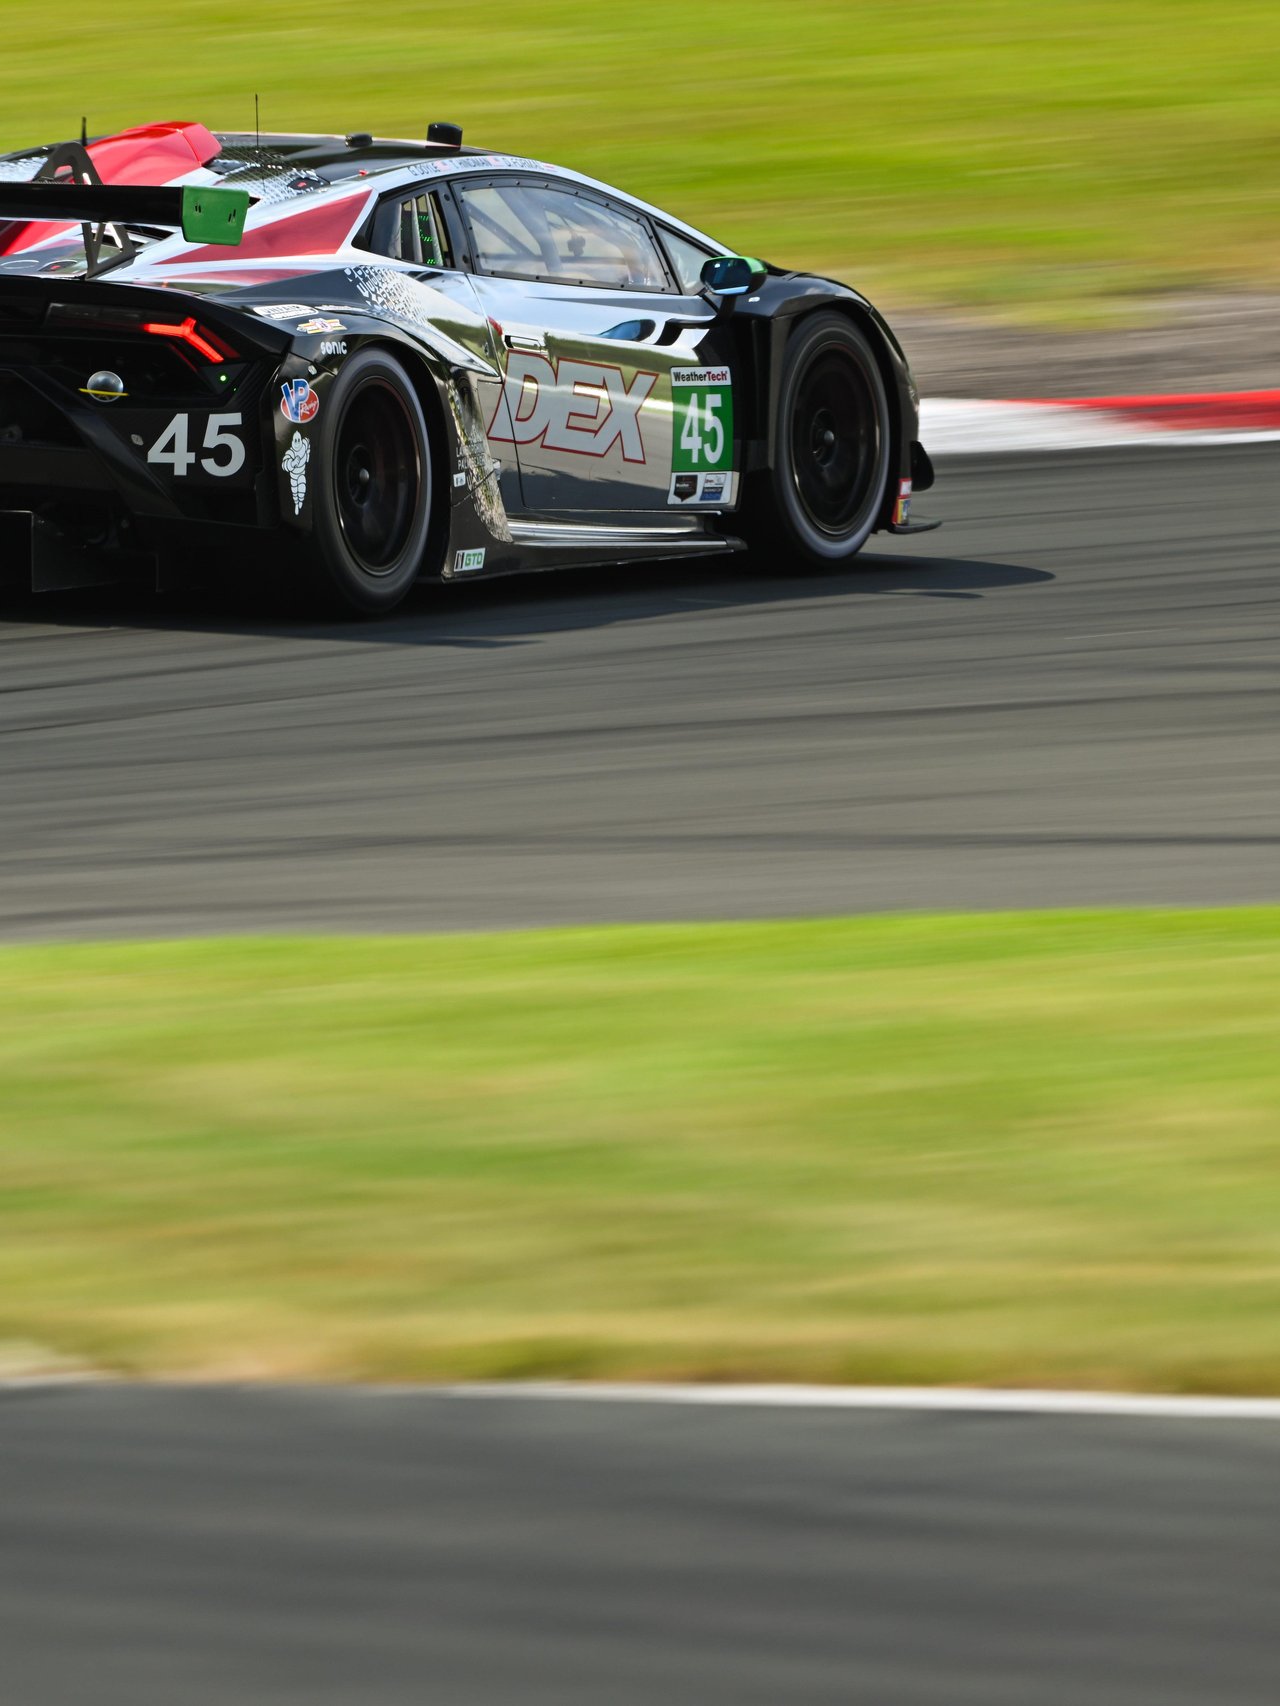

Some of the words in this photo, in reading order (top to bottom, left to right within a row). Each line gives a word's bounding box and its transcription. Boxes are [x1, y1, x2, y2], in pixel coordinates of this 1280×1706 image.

[281, 379, 310, 422] VP
[487, 349, 660, 465] DEX
[680, 392, 724, 464] 45
[147, 412, 246, 477] 45
[465, 552, 483, 567] GTD
